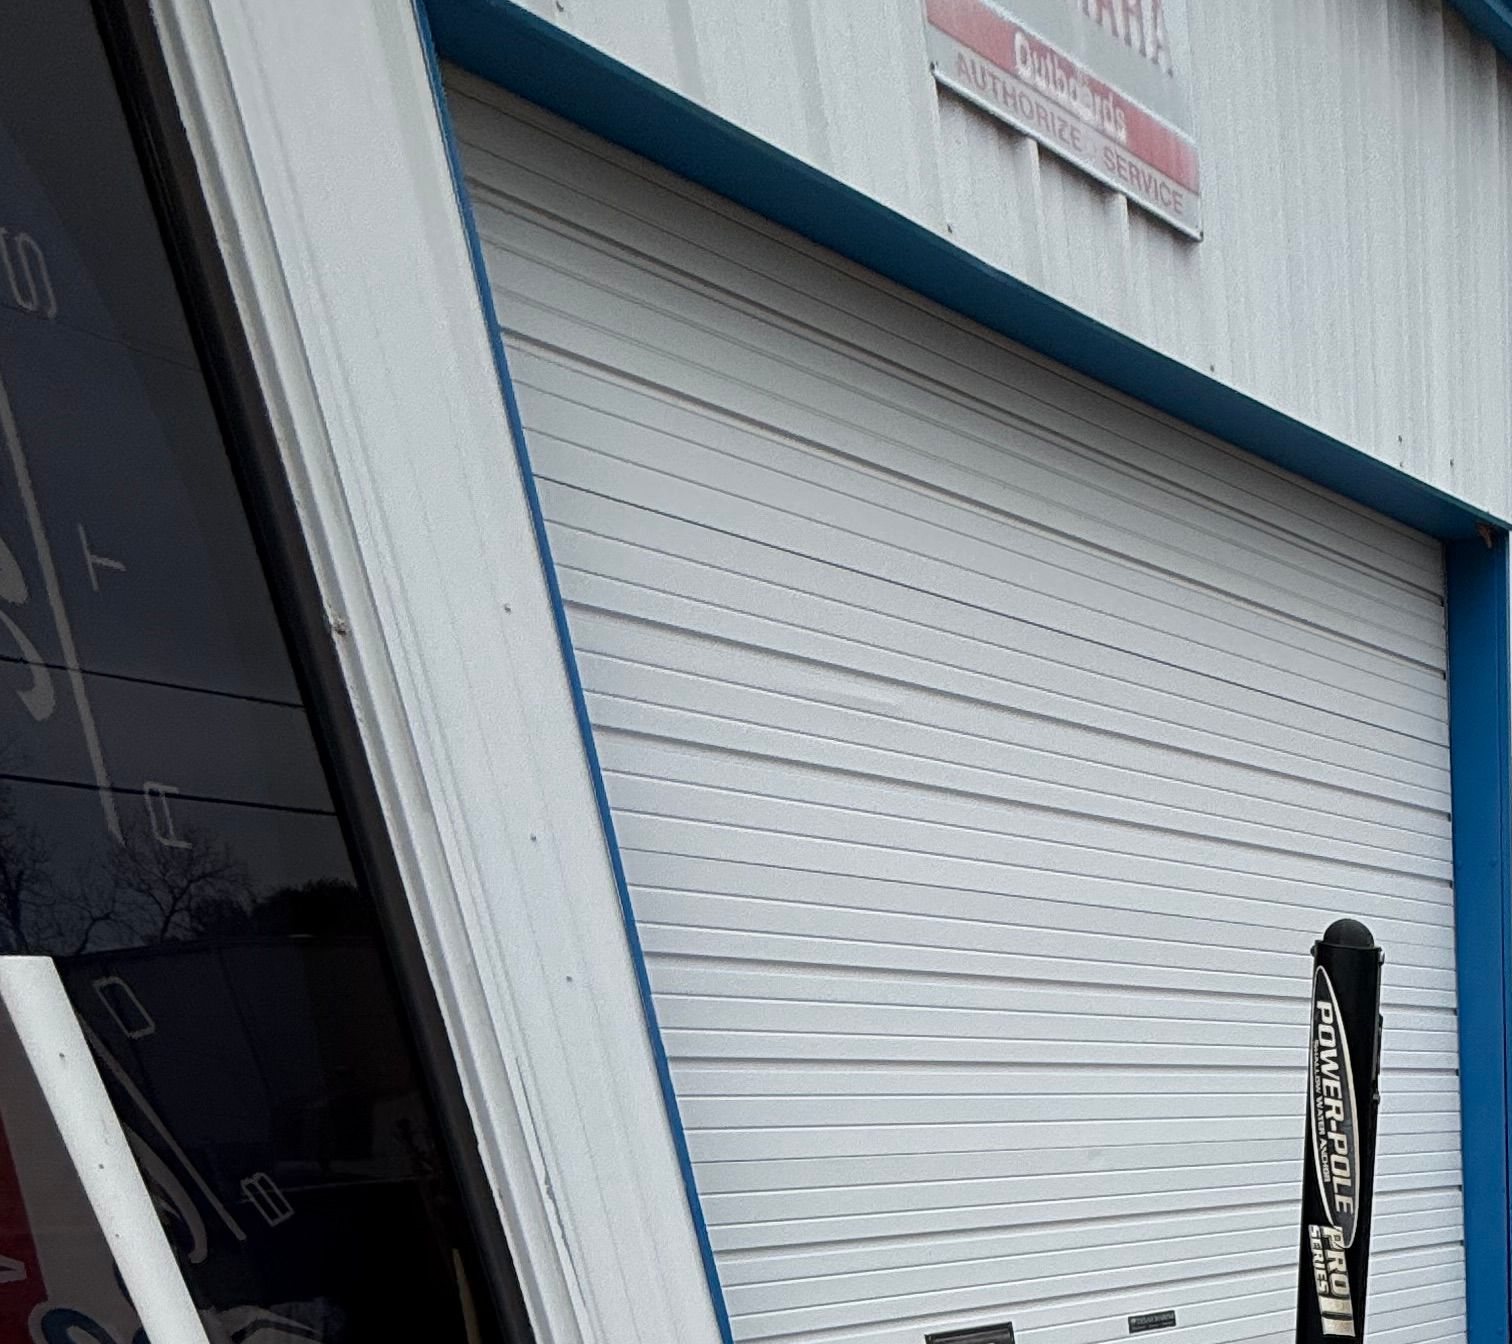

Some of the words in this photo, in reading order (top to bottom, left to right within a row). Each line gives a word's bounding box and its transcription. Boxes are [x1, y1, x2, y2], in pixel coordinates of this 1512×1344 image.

[1103, 146, 1184, 215] SERVICE
[1316, 1000, 1354, 1215] POWER-POLE
[1308, 1224, 1329, 1295] SERIES
[1321, 1225, 1350, 1299] PRO
